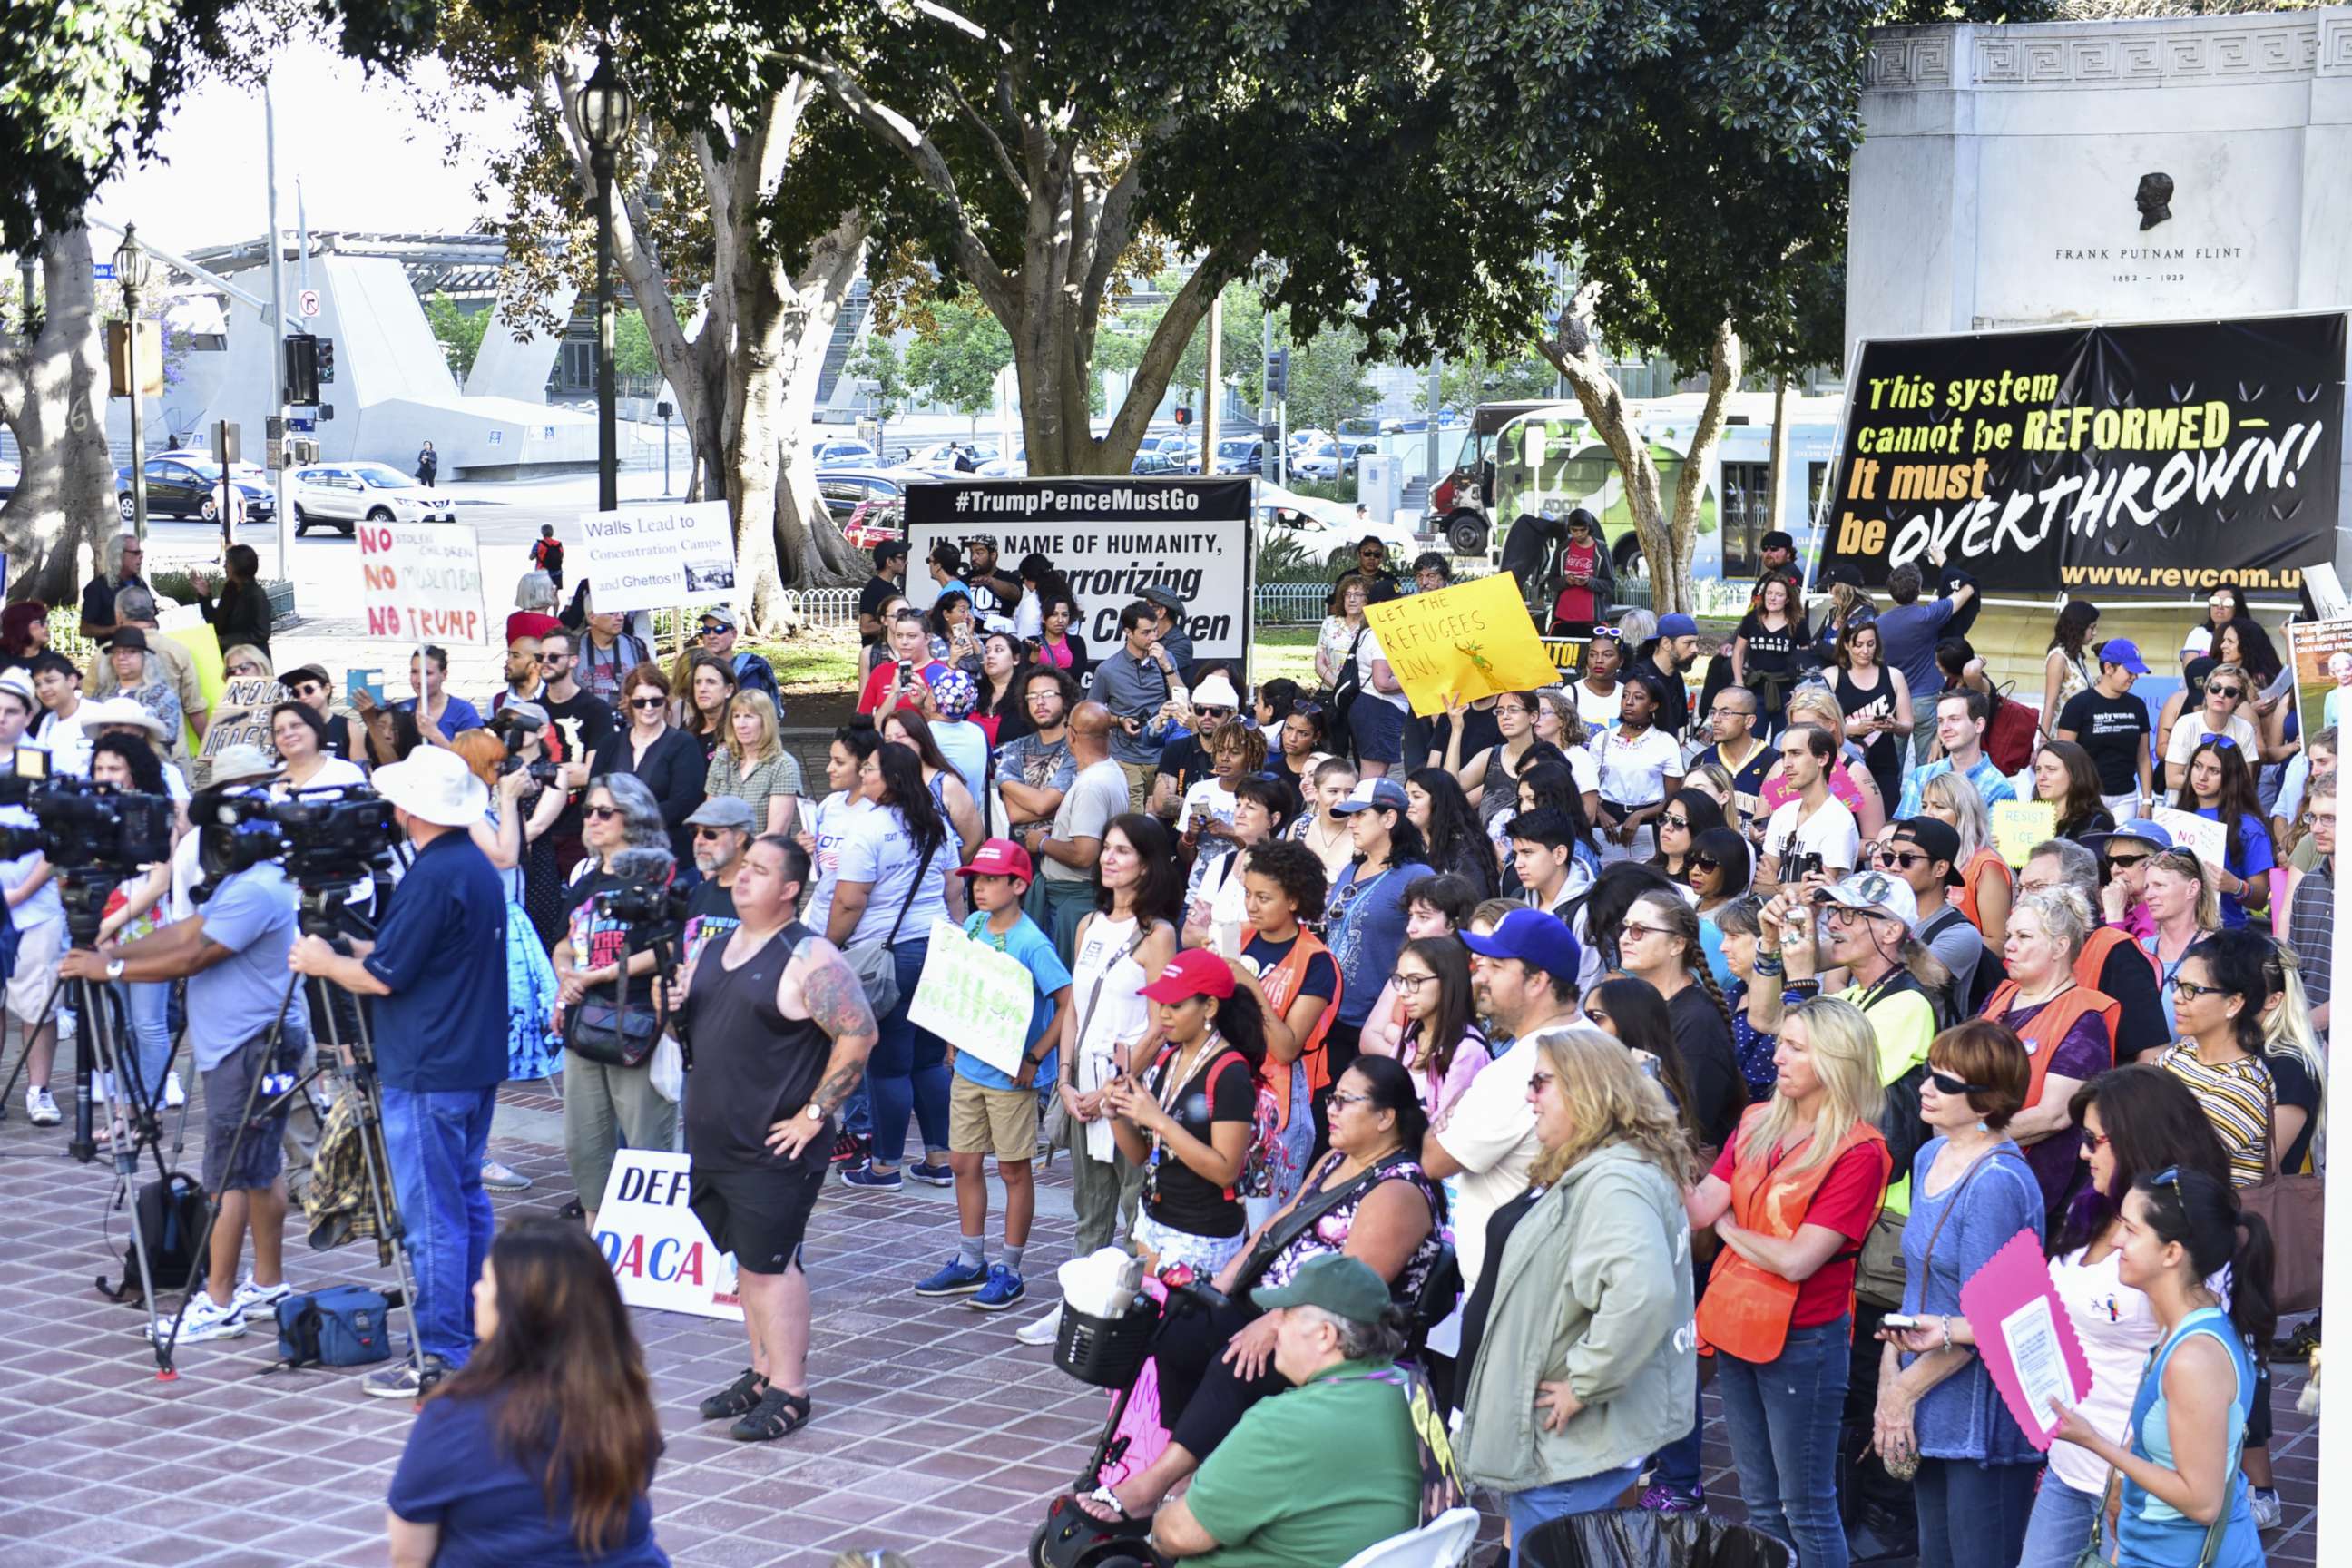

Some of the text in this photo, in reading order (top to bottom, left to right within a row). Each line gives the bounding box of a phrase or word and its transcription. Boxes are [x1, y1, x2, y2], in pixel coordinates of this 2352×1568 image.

[2055, 247, 2242, 260] FRANK PUTNAM FLINT
[2161, 274, 2184, 282] 1929
[1869, 369, 2058, 411] This system
[1857, 417, 1964, 454] cannot
[1972, 418, 2013, 454] be
[2022, 401, 2230, 451] REFORMED
[1847, 457, 1989, 500] It must
[956, 488, 1200, 515] #TrumpPenceMustGo
[1837, 420, 2323, 569] be OVERTHROWN!
[585, 514, 695, 537] Walls Lead to
[359, 525, 392, 555] NO
[590, 538, 722, 561] Concentration Camps
[1004, 535, 1063, 554] NAME
[1073, 534, 1098, 554] OF
[1107, 534, 1222, 555] HUMANITY,
[364, 564, 397, 591] NO
[599, 577, 619, 591] and
[622, 573, 671, 589] Ghettos
[2061, 566, 2304, 589] www.revcom.u
[1376, 593, 1450, 623] LET THE
[368, 605, 476, 641] NO TRUMP
[1384, 610, 1485, 654] REFUGEES
[1395, 652, 1441, 681] IN!
[2178, 829, 2195, 845] NO
[594, 931, 625, 949] THE
[595, 1230, 704, 1287] DACA
